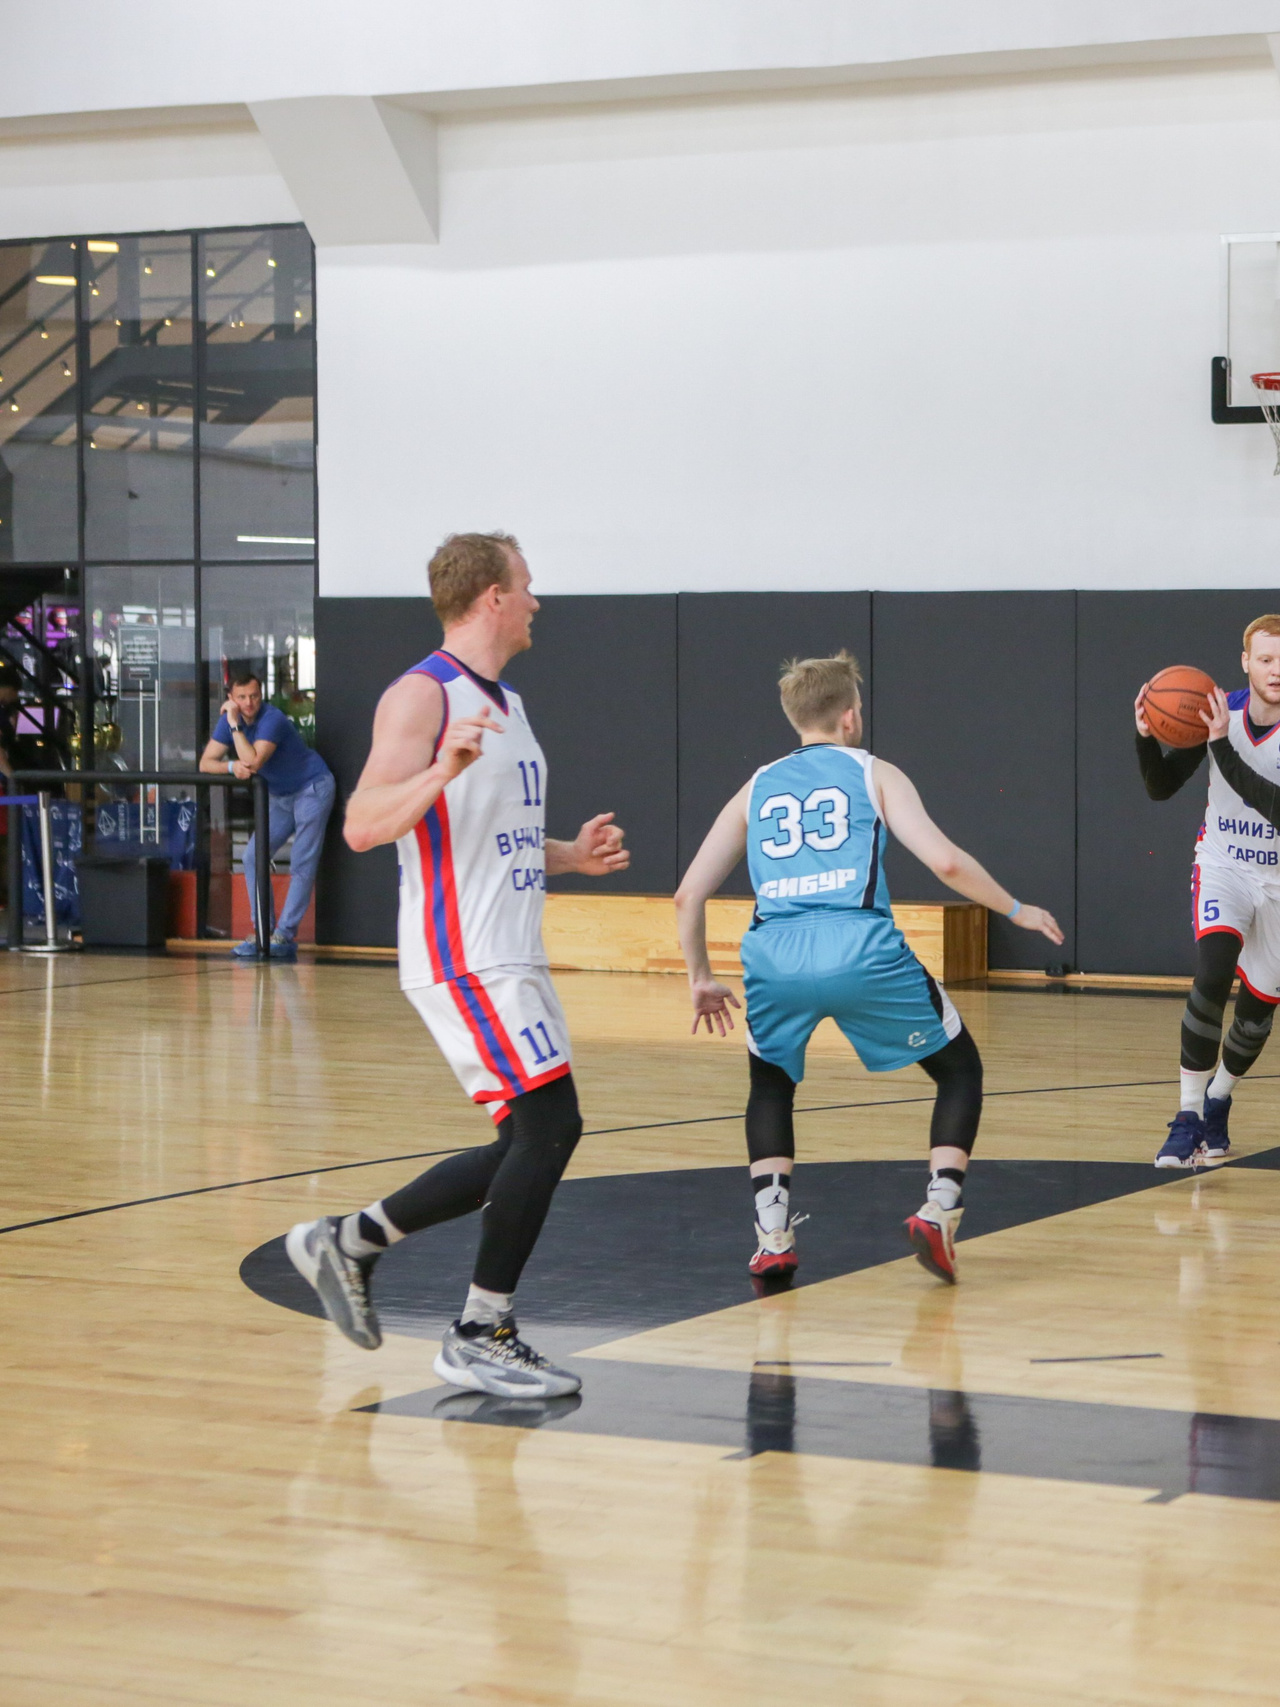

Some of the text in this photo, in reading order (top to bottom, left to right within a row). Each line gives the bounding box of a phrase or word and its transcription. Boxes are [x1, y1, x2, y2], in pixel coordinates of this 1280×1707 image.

[518, 760, 541, 806] 11
[759, 786, 850, 860] 33
[759, 868, 857, 899] СИБУР
[1203, 899, 1220, 922] 5
[519, 1020, 559, 1065] 11
